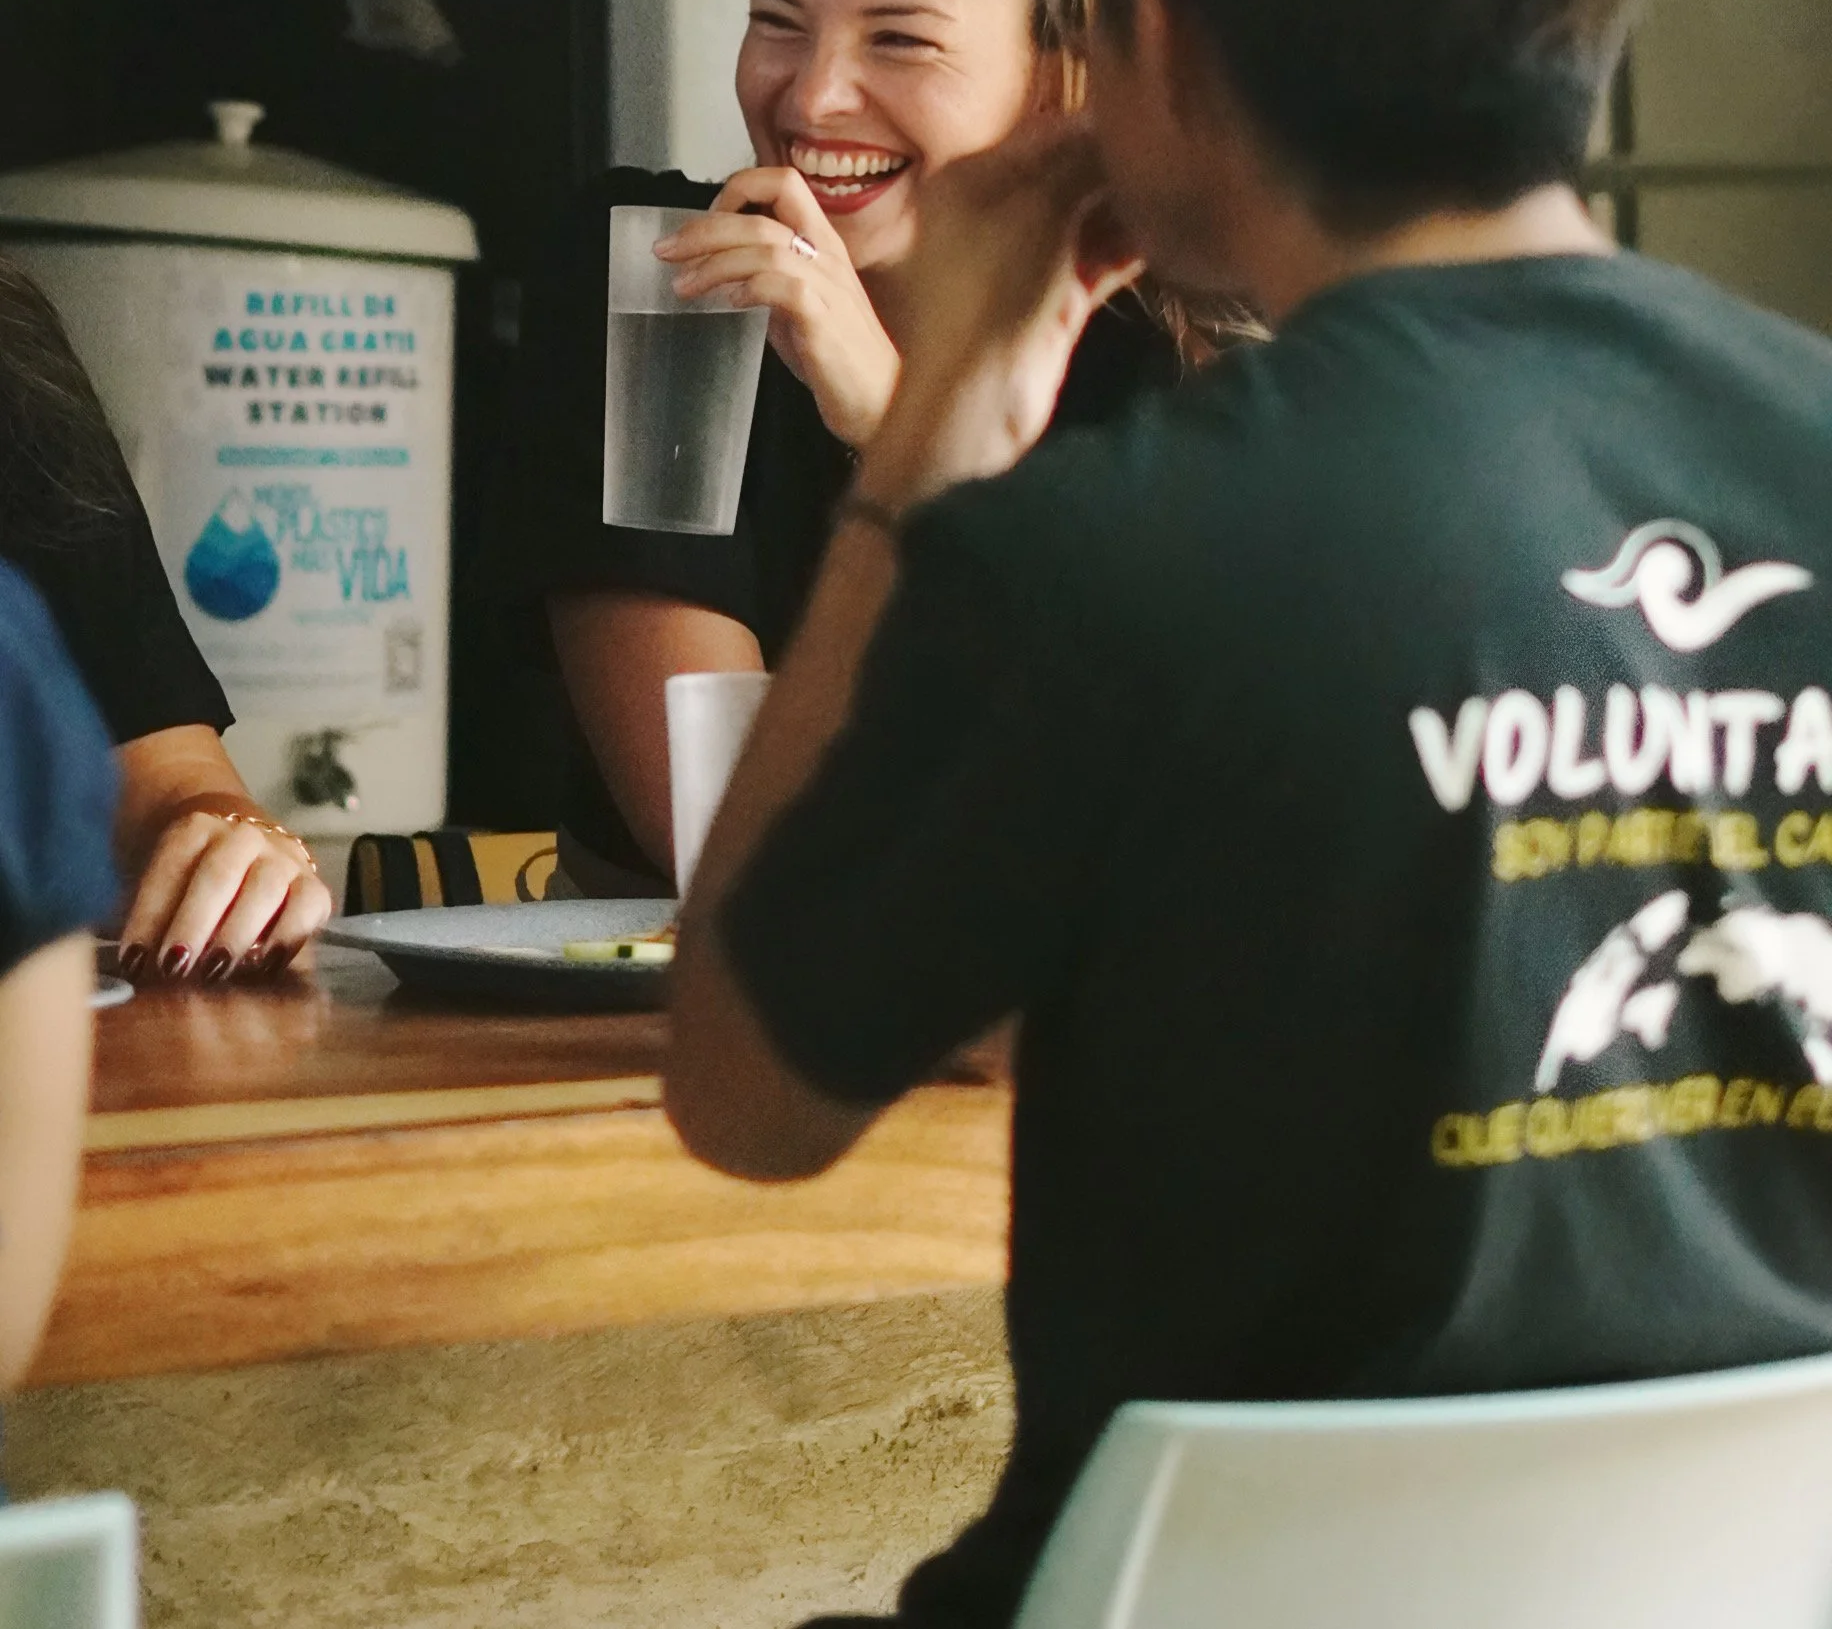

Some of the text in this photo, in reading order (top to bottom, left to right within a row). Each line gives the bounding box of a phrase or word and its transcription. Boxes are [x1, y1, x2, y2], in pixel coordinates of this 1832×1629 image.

[246, 291, 396, 318] REFILL DE
[213, 327, 416, 354] AGUA GRATIS
[203, 365, 420, 390] WATER REFILL
[247, 401, 388, 425] STATION
[334, 546, 412, 603] VIDA
